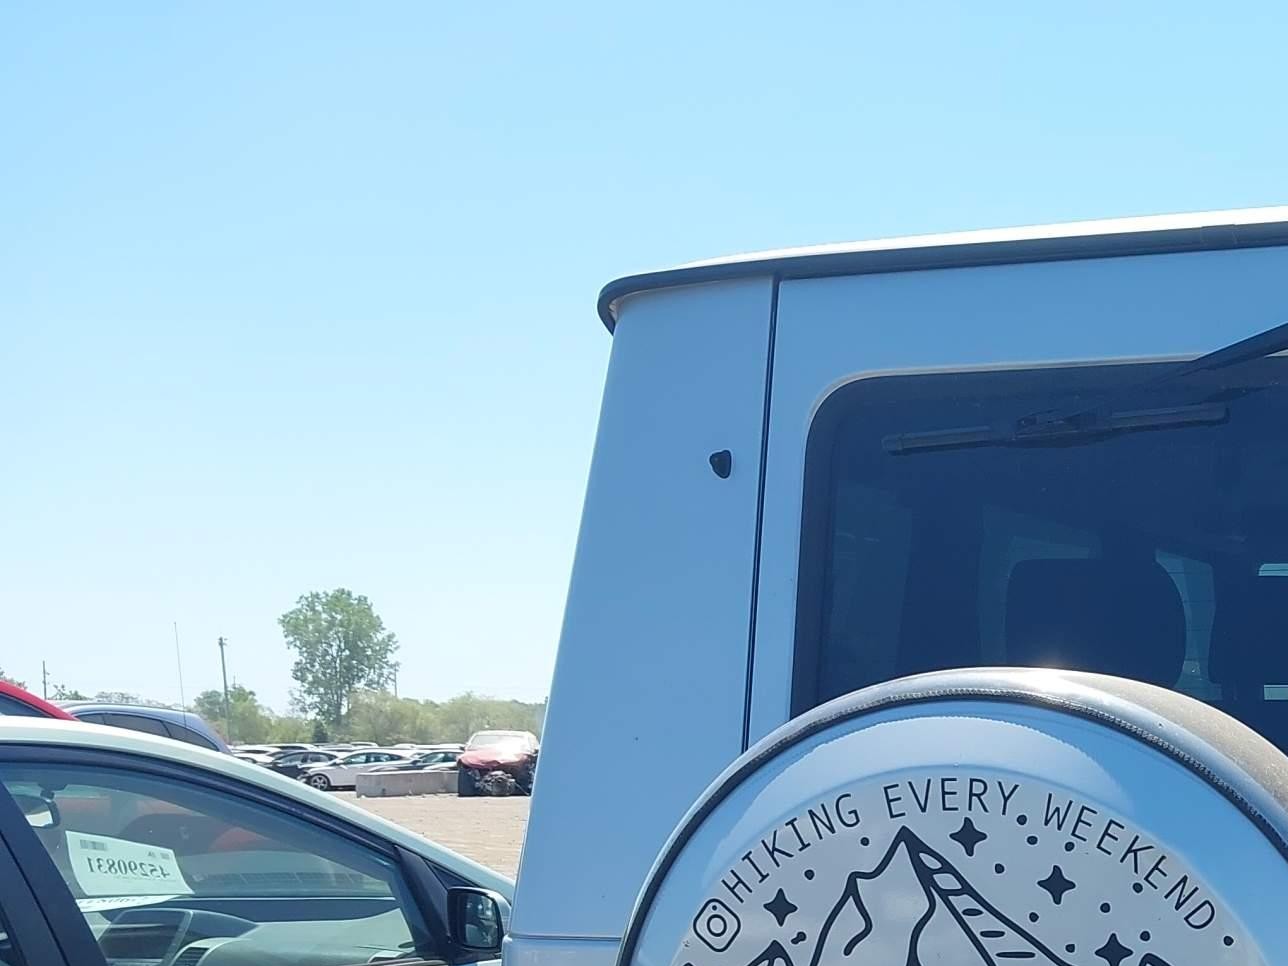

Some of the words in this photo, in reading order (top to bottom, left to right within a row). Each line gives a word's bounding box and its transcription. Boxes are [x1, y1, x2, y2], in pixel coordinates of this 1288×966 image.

[721, 793, 861, 903] HIKING
[883, 777, 1020, 819] EVERY
[1043, 792, 1216, 930] WEEKEND
